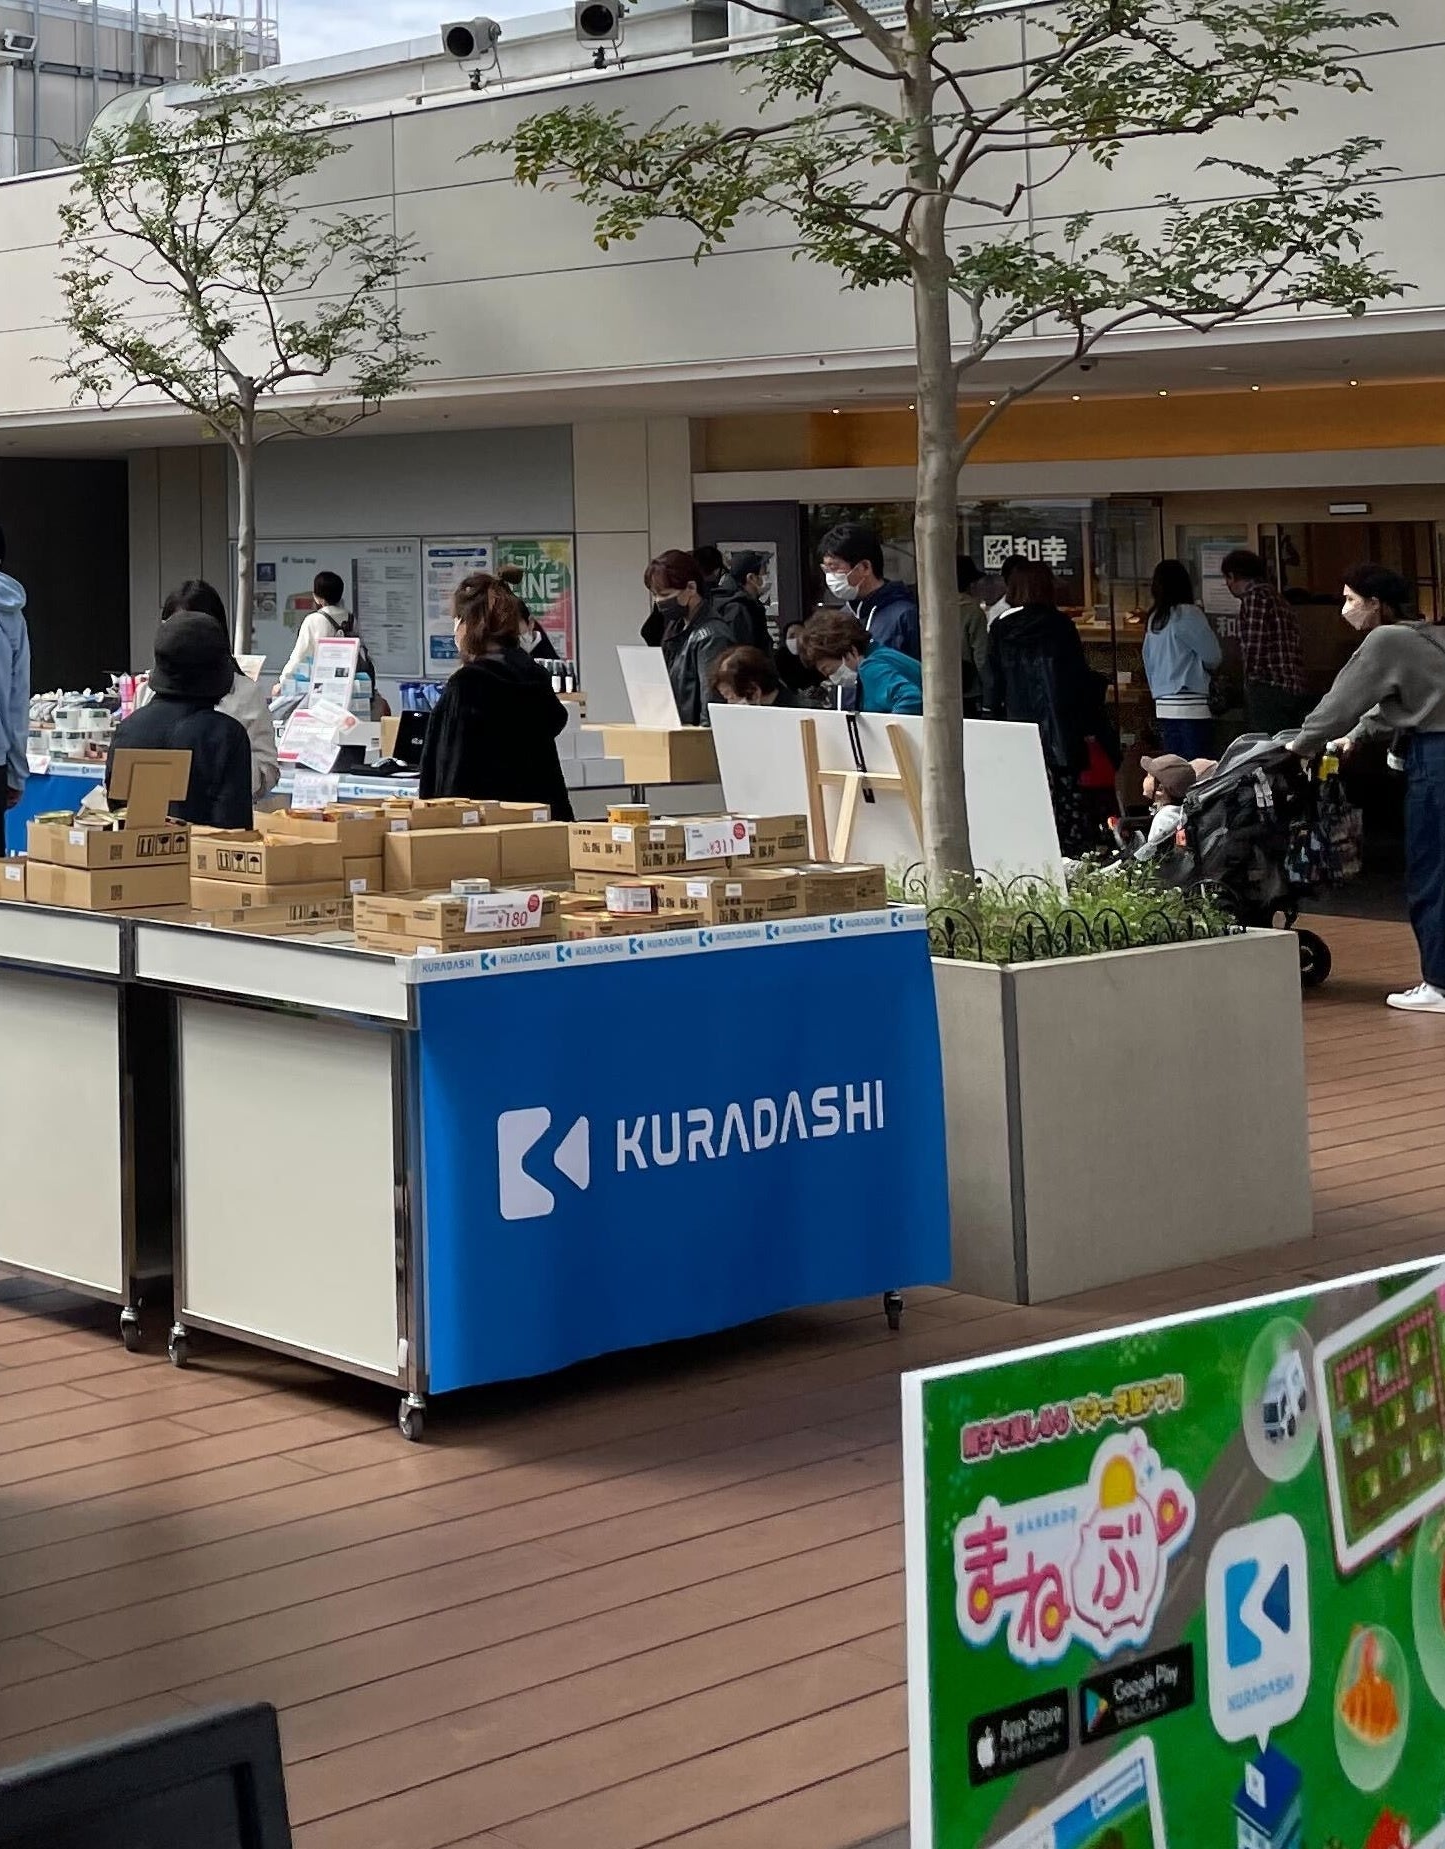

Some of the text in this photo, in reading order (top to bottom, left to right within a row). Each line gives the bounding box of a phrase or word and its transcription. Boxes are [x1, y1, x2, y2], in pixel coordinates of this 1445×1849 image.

[497, 910, 529, 929] ¥180
[422, 958, 474, 974] KURADASHI
[500, 950, 550, 966] KURADASHI
[575, 942, 624, 957] KURADASHI
[616, 1079, 885, 1173] KURADASHI
[963, 1512, 1142, 1648] まねぶ
[1113, 1663, 1178, 1700] Google Play
[1001, 1705, 1062, 1742] App Store
